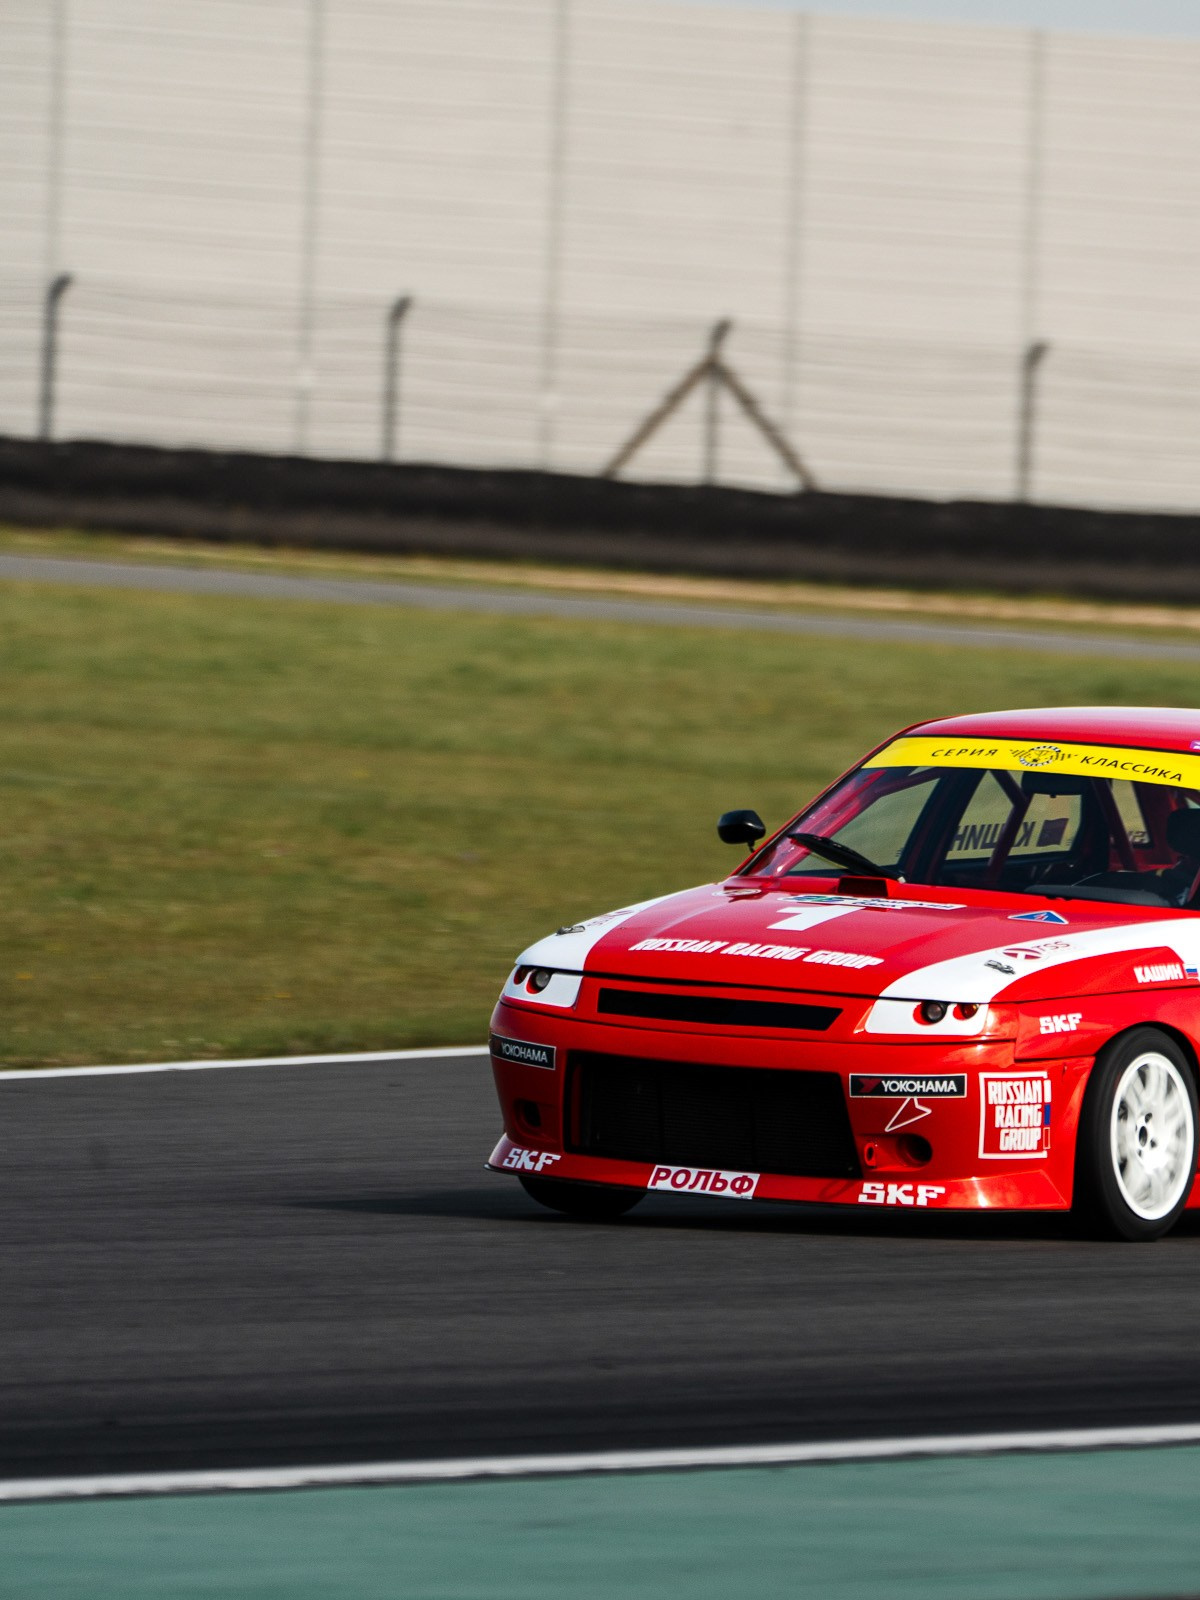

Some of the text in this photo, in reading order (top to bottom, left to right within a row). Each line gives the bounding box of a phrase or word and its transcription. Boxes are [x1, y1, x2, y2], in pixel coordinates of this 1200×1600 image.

[931, 748, 1183, 782] СЕРИЯ КЛАССИКА
[767, 904, 867, 931] 1
[628, 938, 885, 969] RUSSIAN RACING GROUP
[1133, 964, 1184, 984] КАШИН
[1038, 1013, 1082, 1034] SKF
[501, 1042, 548, 1063] YOKOHAMA
[882, 1079, 957, 1093] YOKOHAMA
[988, 1080, 1042, 1105] RUSSIAN
[995, 1105, 1042, 1128] RACING
[1000, 1128, 1042, 1151] GROUP
[502, 1148, 561, 1171] SKF
[650, 1167, 755, 1195] РОЛЬФ
[858, 1182, 946, 1206] SKF
